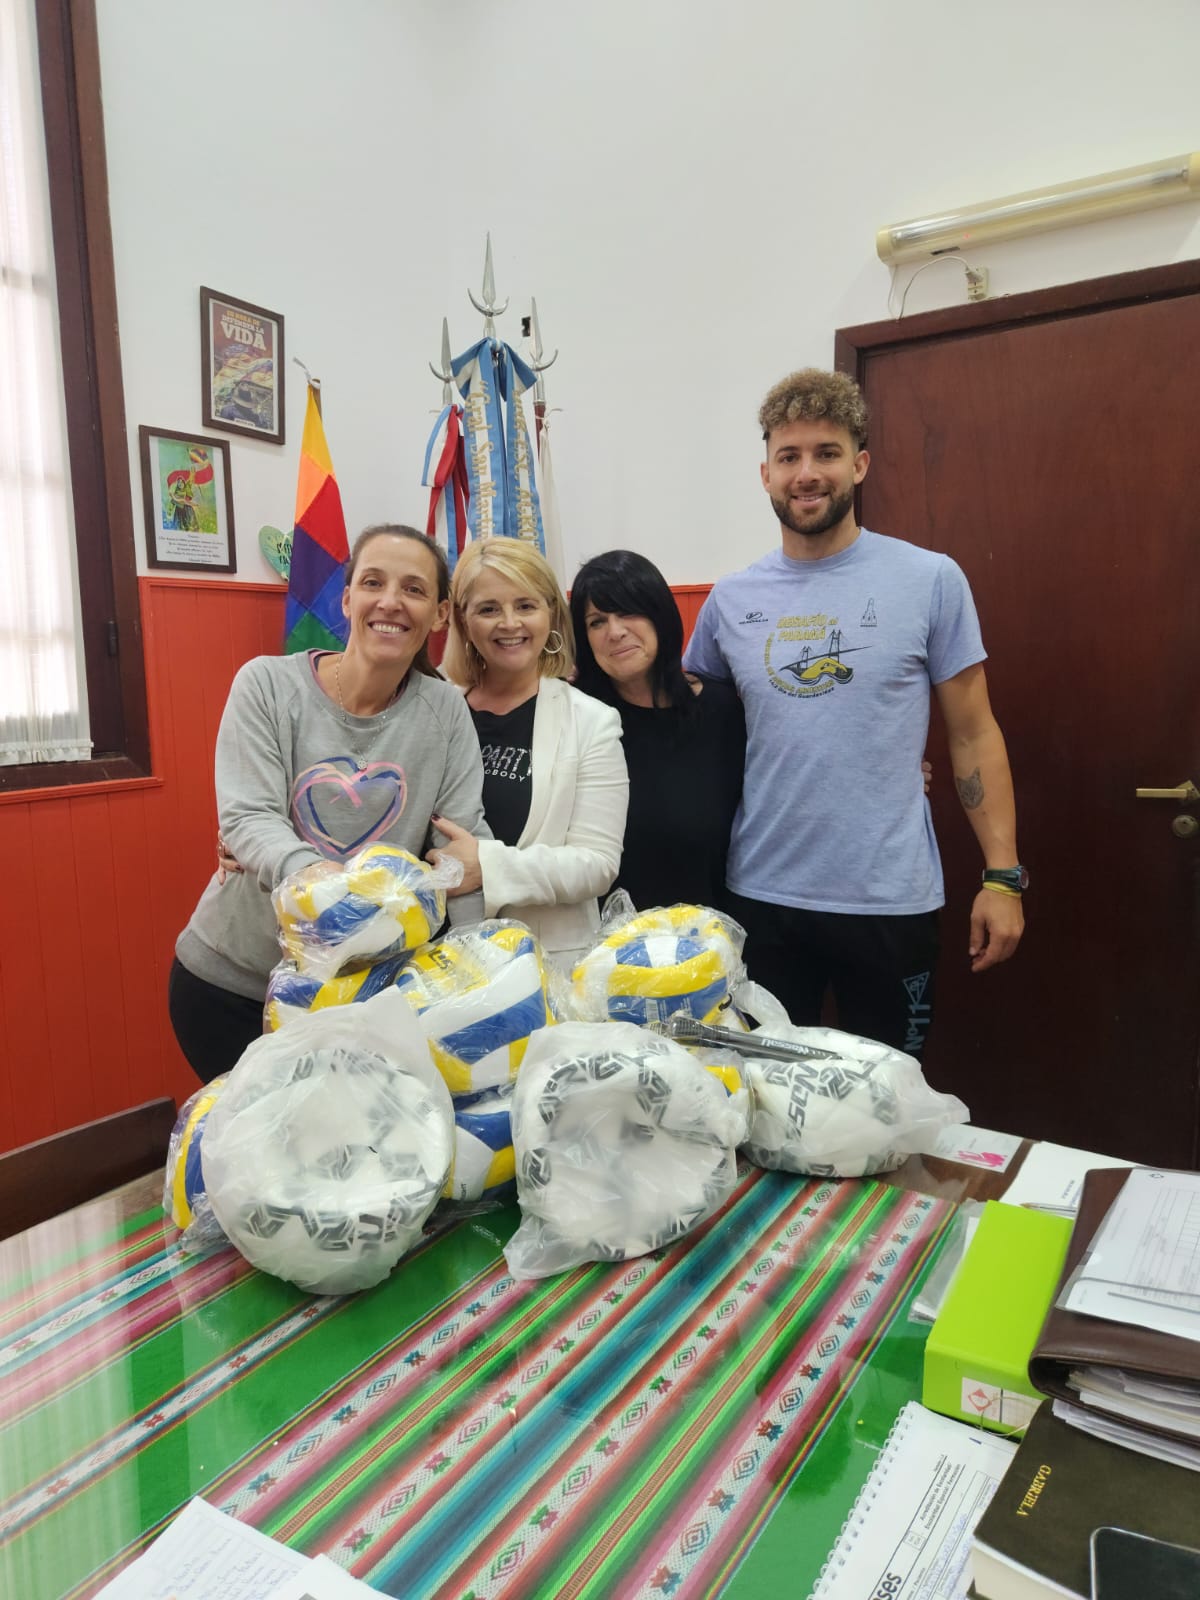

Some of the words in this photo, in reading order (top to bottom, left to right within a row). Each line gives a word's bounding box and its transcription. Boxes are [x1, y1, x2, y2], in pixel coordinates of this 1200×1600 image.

[220, 320, 267, 351] VIDA
[471, 441, 494, 477] San
[484, 768, 526, 782] OBODY
[1016, 1465, 1051, 1515] GABRIELA
[873, 1572, 902, 1600] ses
